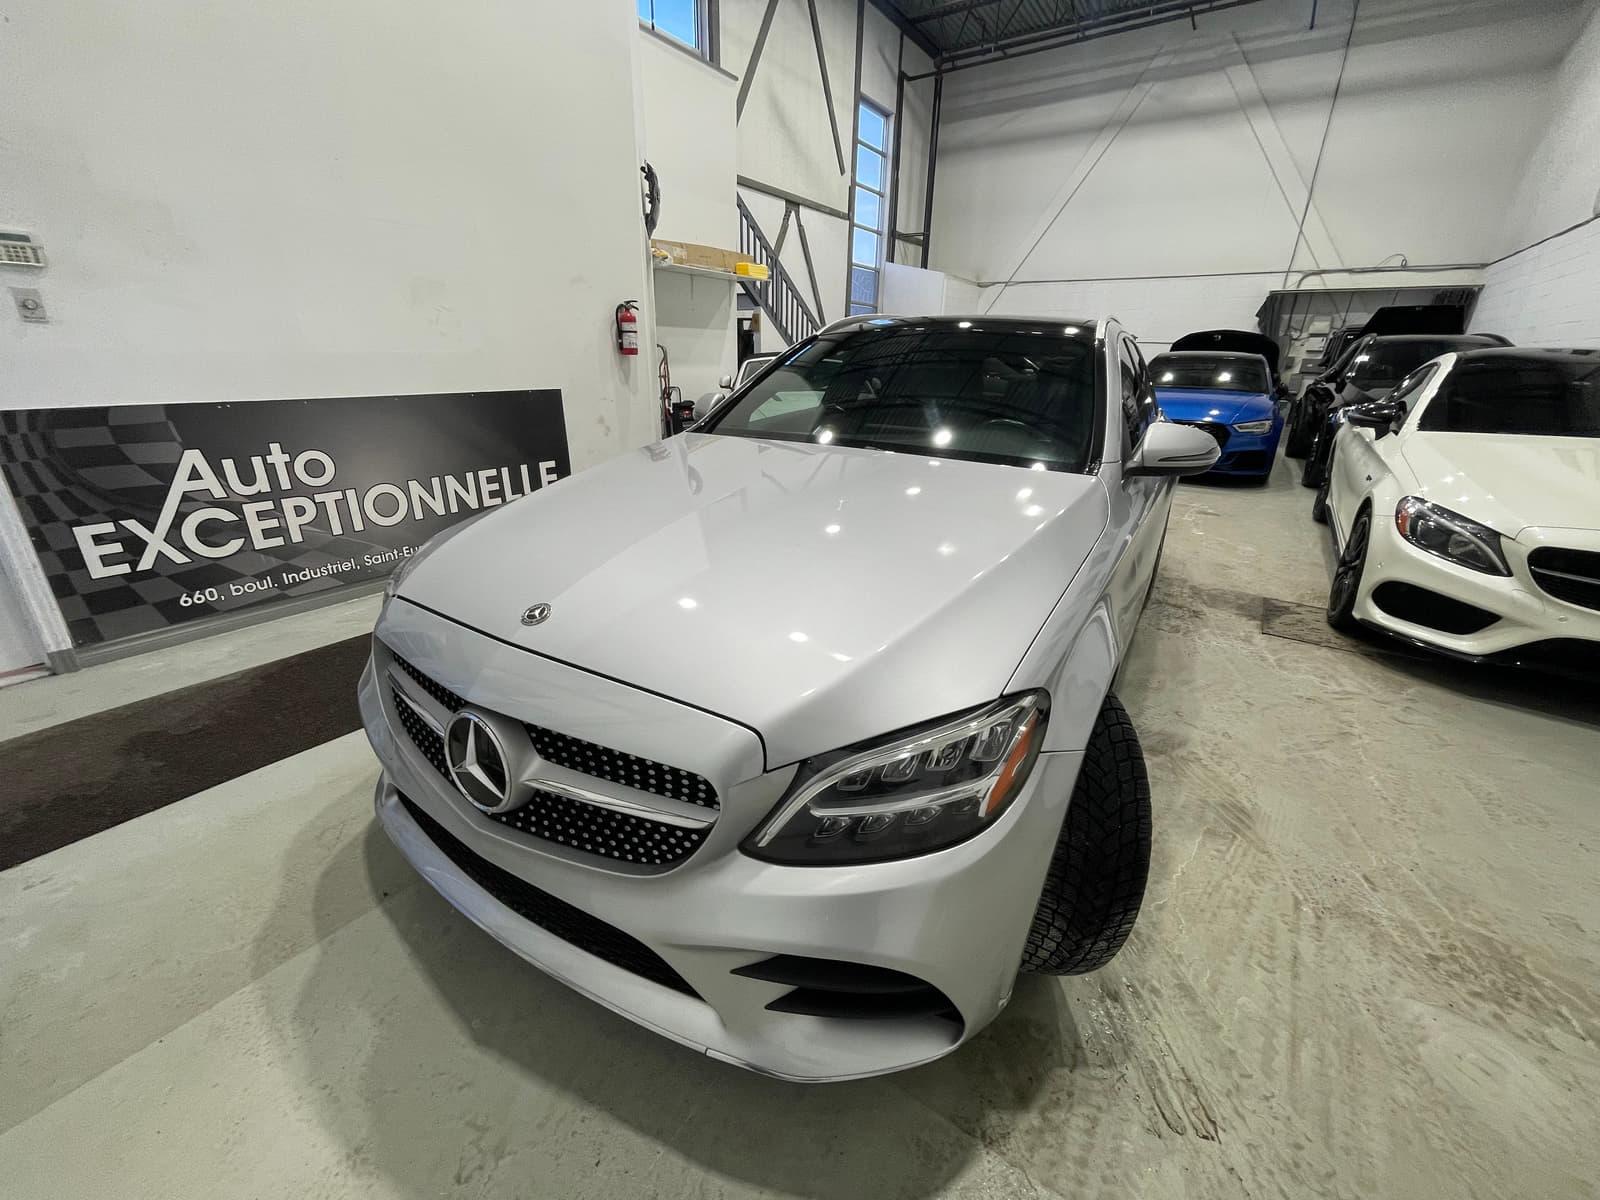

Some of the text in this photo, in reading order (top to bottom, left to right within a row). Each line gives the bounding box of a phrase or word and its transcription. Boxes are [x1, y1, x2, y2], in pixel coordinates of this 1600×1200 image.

[173, 442, 336, 499] Auto
[71, 459, 558, 580] EXCEPTIONNELLE
[179, 587, 226, 607] 660,
[229, 574, 279, 597] boul.
[282, 558, 361, 585] Industriel,
